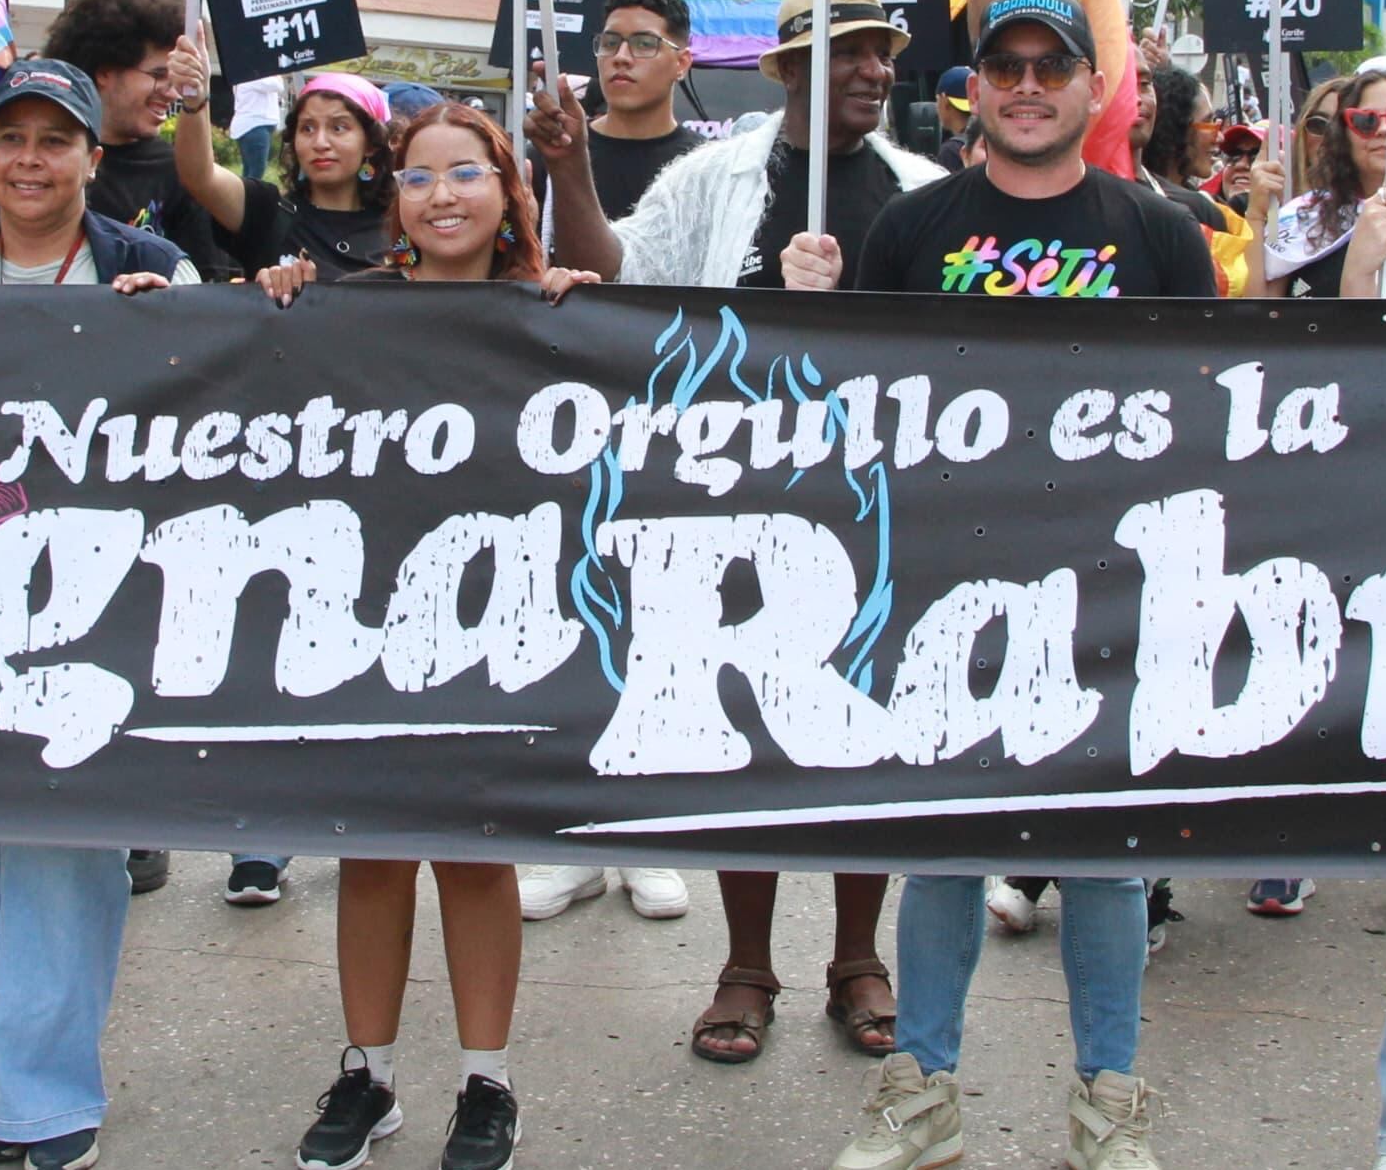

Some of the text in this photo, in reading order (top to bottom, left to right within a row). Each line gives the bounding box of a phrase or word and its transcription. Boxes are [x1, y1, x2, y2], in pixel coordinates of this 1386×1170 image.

[262, 9, 320, 48] #11
[516, 374, 1010, 496] Orgullo
[1049, 388, 1173, 461] es
[1216, 361, 1349, 461] la
